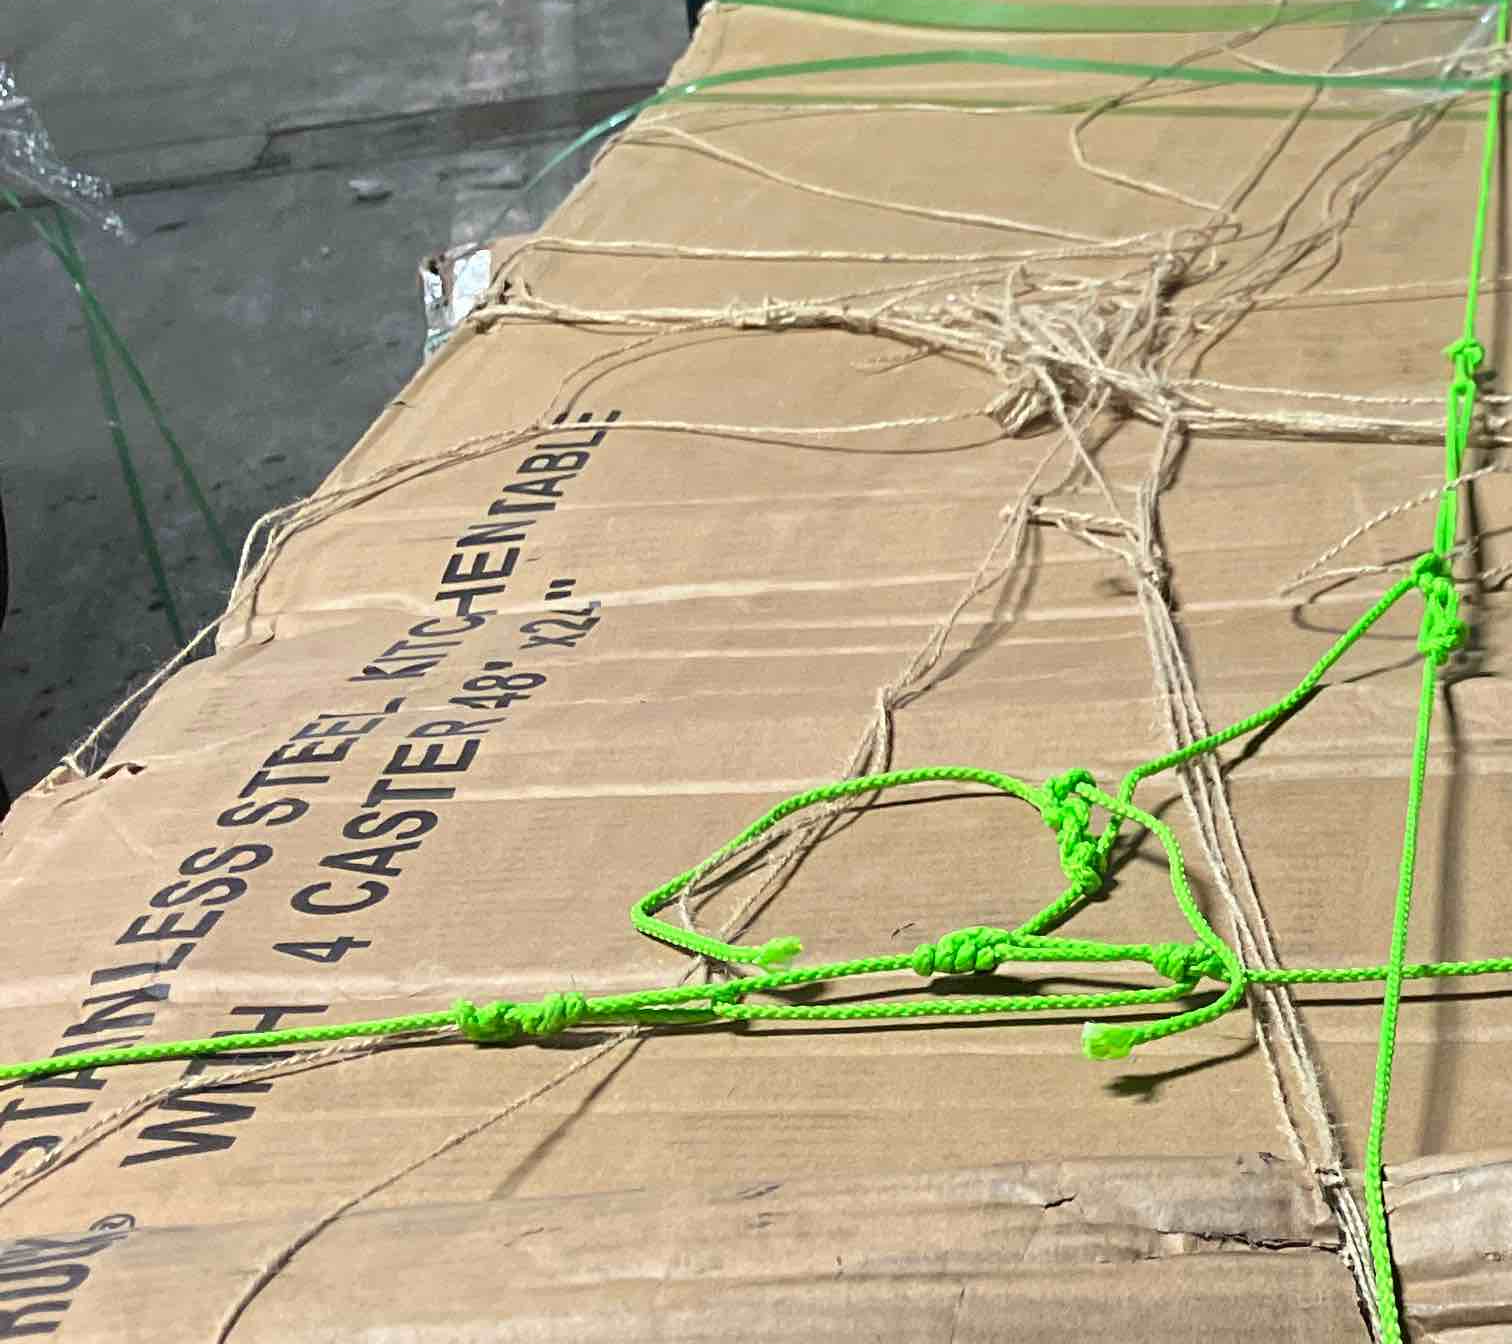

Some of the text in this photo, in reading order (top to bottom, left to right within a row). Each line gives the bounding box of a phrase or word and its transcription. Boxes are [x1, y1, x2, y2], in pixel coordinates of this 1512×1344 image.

[290, 716, 507, 916] CASTER
[0, 843, 274, 1189] STAINLESS
[216, 697, 406, 827] STEEL
[272, 936, 372, 964] 4
[119, 1003, 329, 1168] WITH
